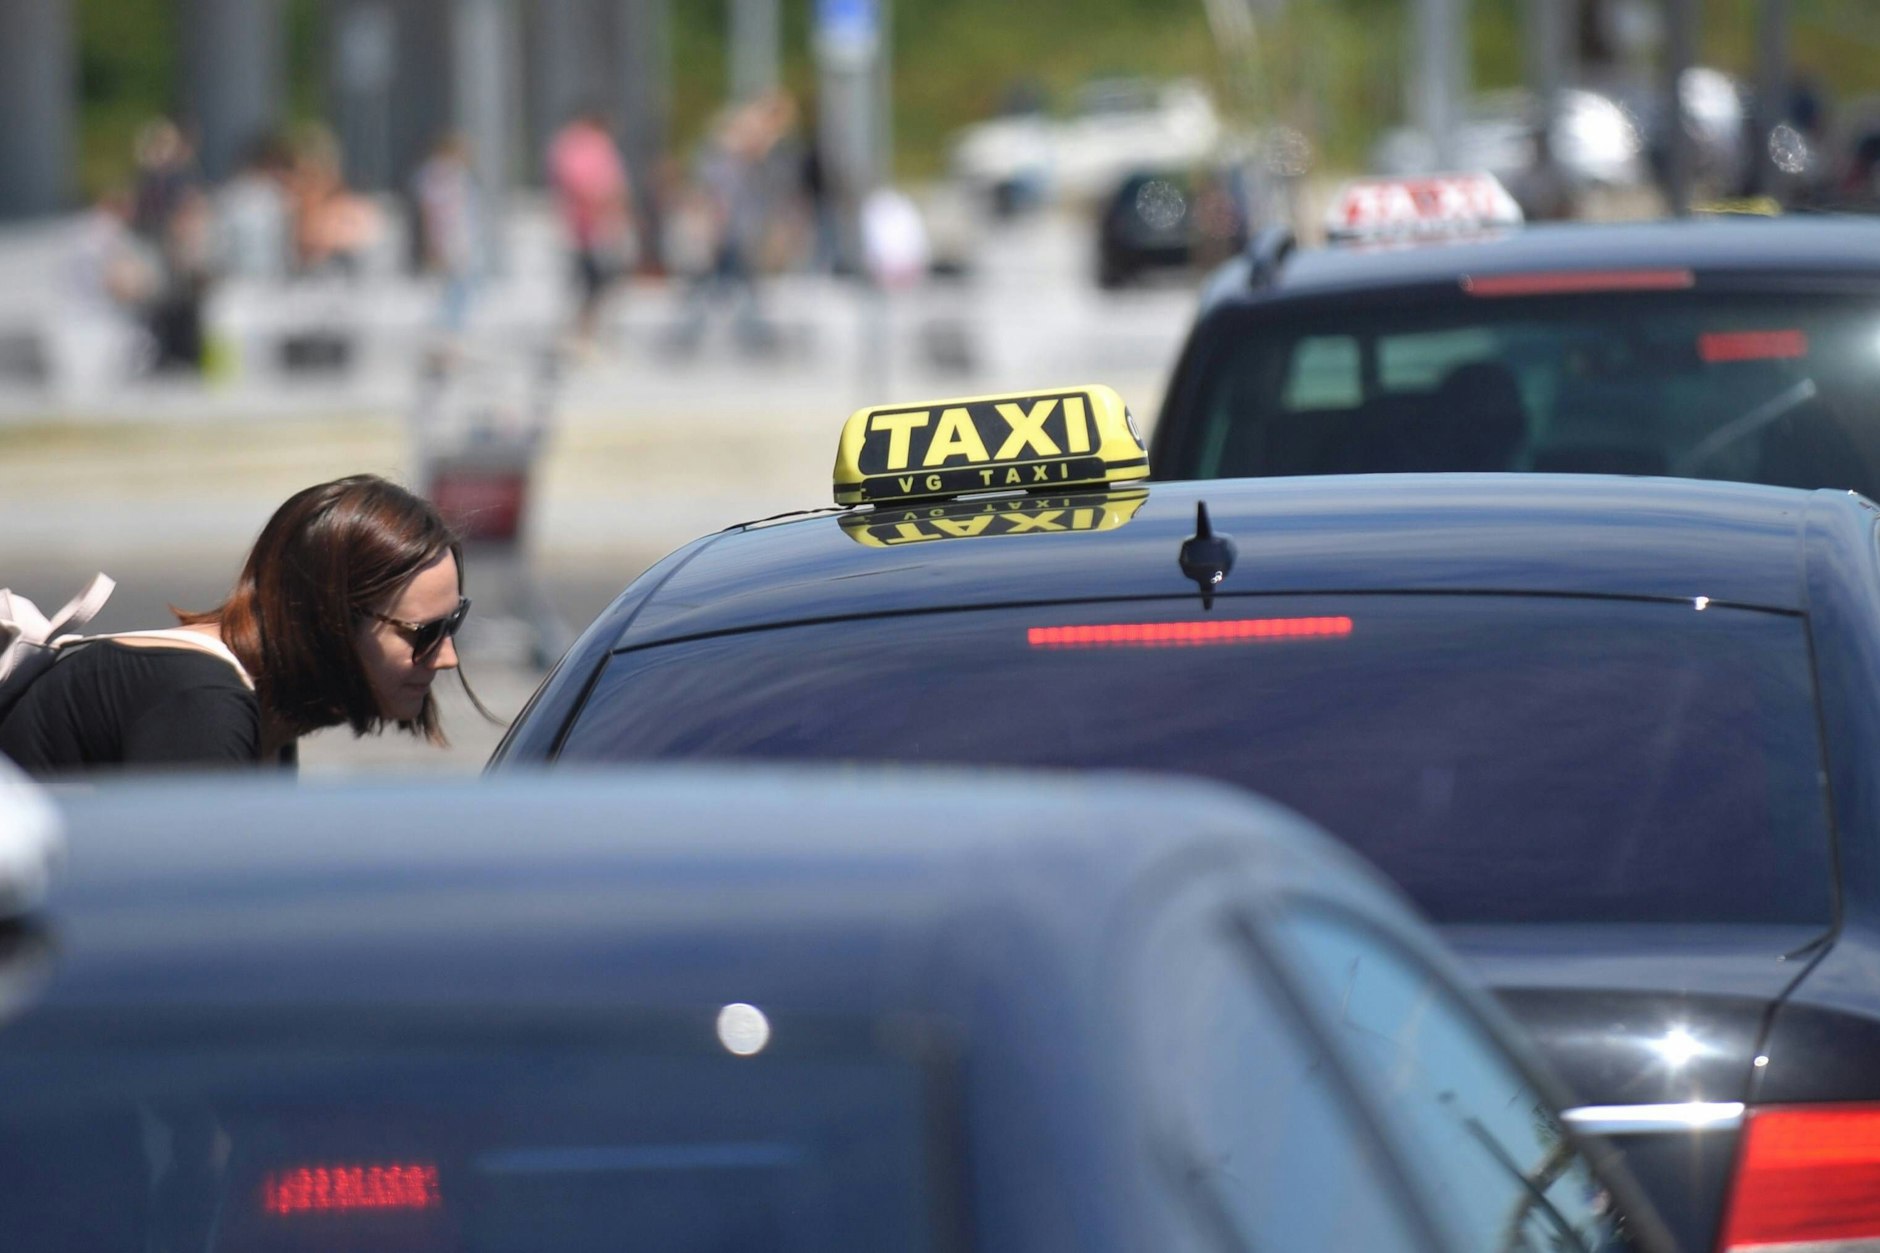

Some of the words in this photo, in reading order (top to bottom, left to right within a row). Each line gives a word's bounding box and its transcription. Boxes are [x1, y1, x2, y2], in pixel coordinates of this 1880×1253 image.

[870, 396, 1091, 470] TAXI
[898, 475, 943, 493] VG
[979, 462, 1069, 486] TAXI
